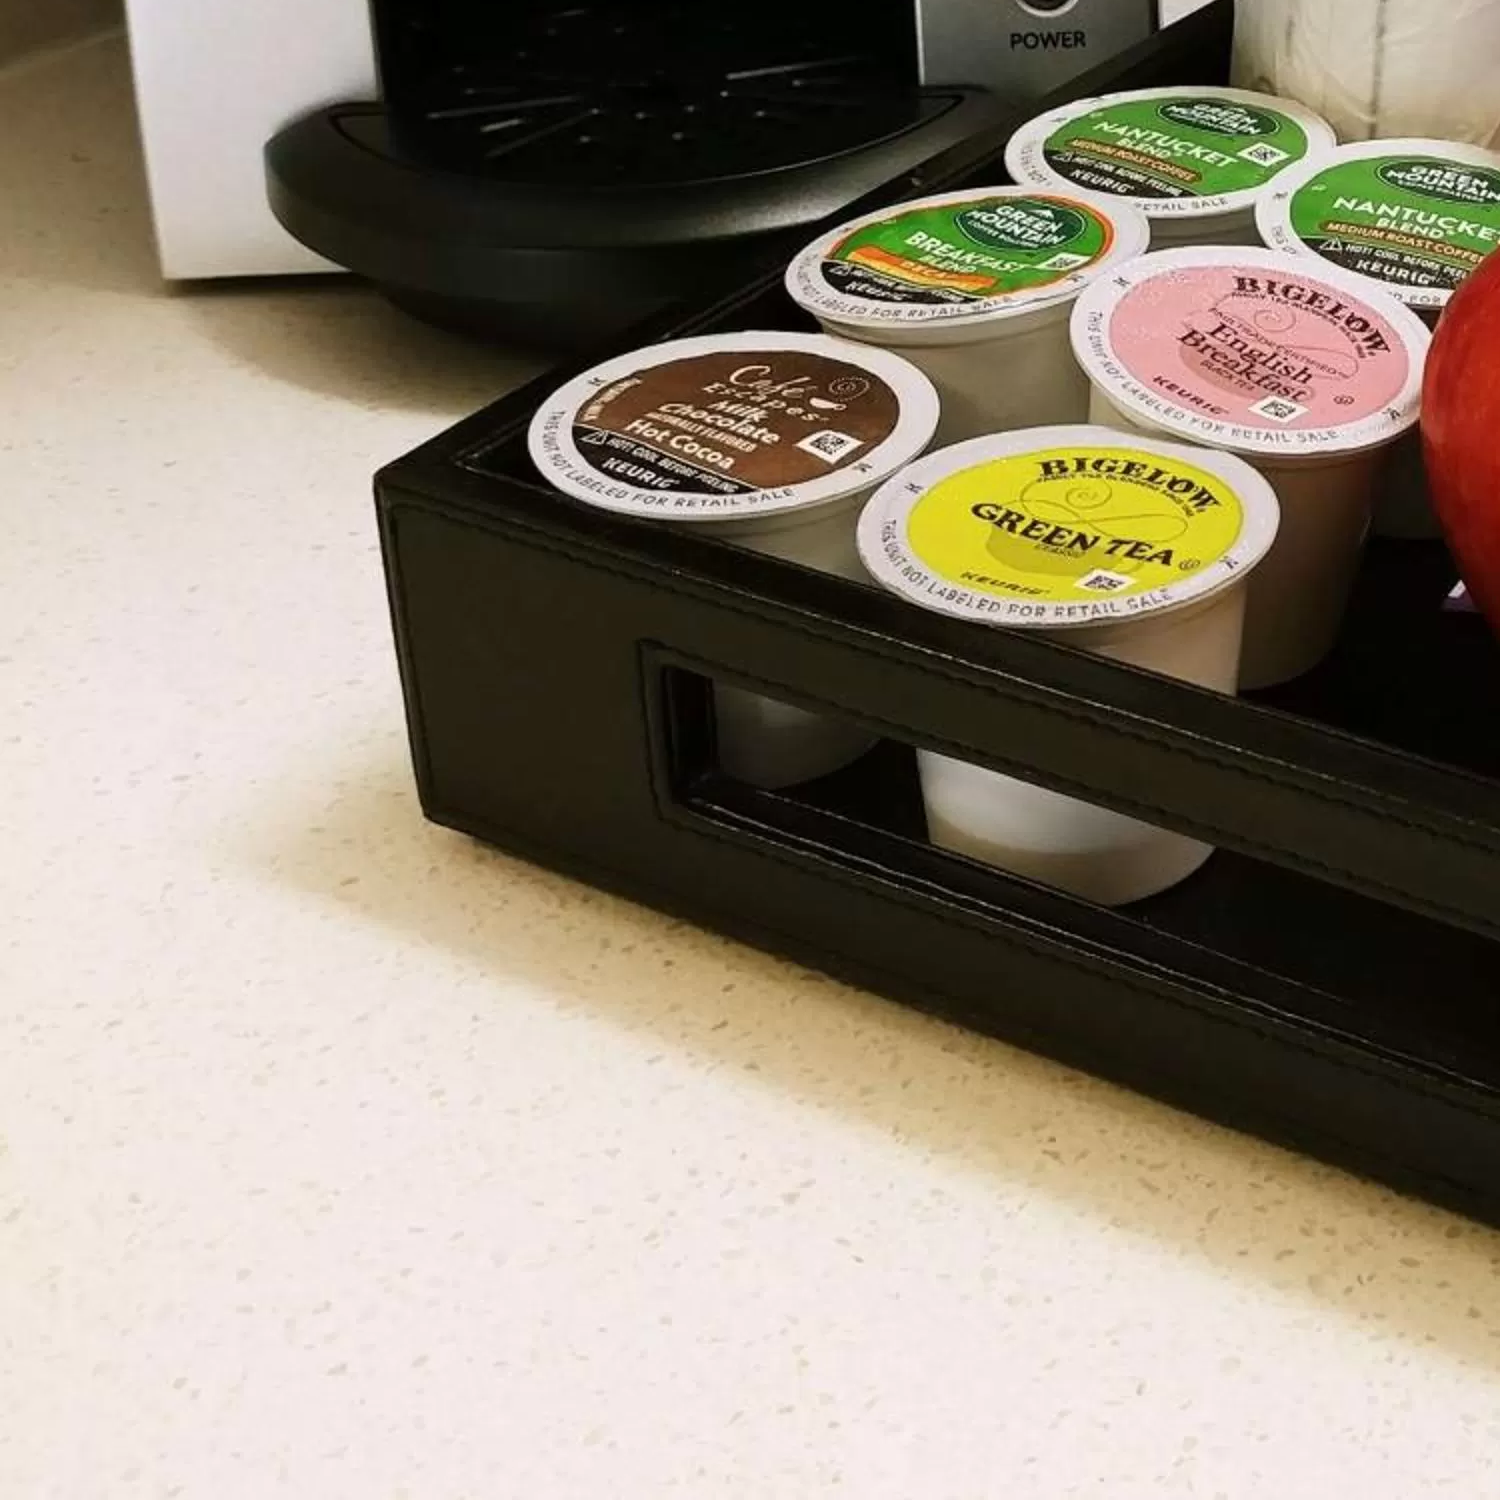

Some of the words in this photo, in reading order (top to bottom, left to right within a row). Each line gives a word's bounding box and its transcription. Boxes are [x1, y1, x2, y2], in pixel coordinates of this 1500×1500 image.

[1009, 30, 1086, 51] POWER
[1092, 120, 1239, 168] NANTUCKET
[1115, 137, 1172, 159] BLEND
[1070, 168, 1131, 193] KEURIG
[1411, 164, 1489, 188] GREEN
[965, 208, 1067, 245] MOUNTAIN
[995, 204, 1065, 233] GREEN
[1326, 222, 1385, 239] MEDIUM
[1385, 233, 1432, 250] ROAST
[1375, 217, 1444, 240] BLEND
[905, 230, 1031, 273] BREAKFAST
[1355, 259, 1430, 285] KEURIG
[1231, 275, 1391, 355] BIGELOW
[1176, 328, 1307, 401] Breakfast
[1205, 321, 1314, 385] English
[708, 399, 771, 423] Milk
[1152, 375, 1225, 416] KEURIG
[657, 402, 781, 445] Chocolate
[623, 418, 671, 443] Hot
[669, 434, 736, 470] Cocoa
[564, 469, 629, 500] LABELED
[632, 493, 670, 505] FOR
[673, 498, 741, 508] RETAIL
[750, 488, 793, 504] SALE
[601, 457, 674, 489] KEURIG
[1038, 456, 1221, 509] BIGELOW
[970, 503, 1101, 552] GREEN
[1103, 538, 1174, 567] TEA
[927, 582, 1001, 613] LABELED
[1007, 604, 1046, 617] FOR
[1054, 602, 1121, 618] RETAIL
[1126, 588, 1174, 610] SALE
[959, 571, 1043, 595] KEURIG
